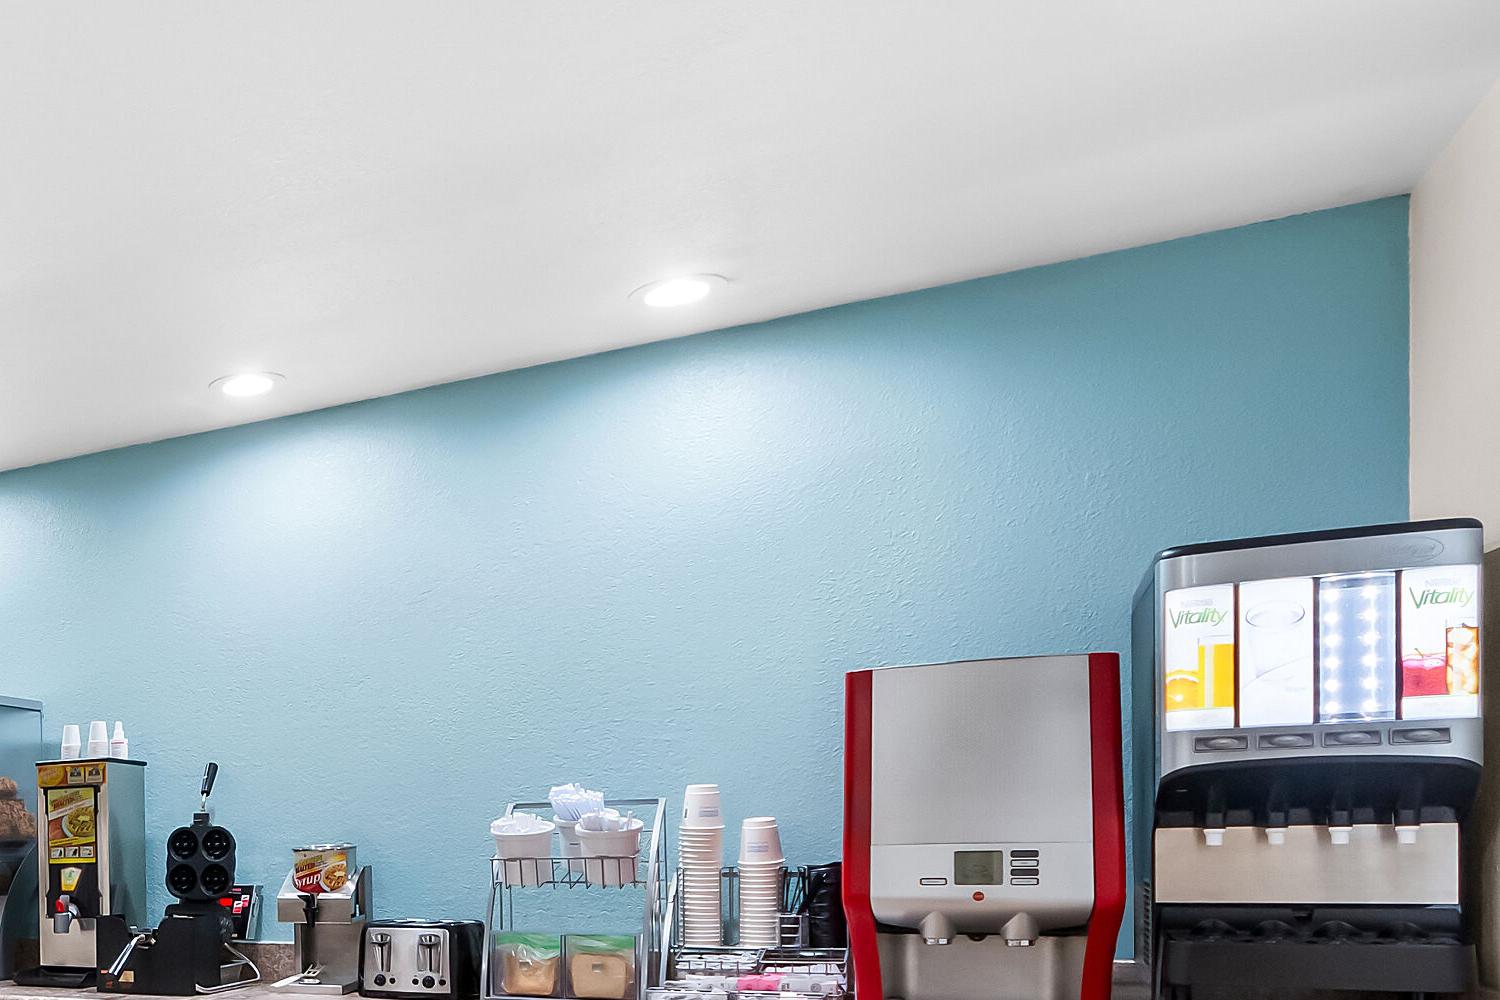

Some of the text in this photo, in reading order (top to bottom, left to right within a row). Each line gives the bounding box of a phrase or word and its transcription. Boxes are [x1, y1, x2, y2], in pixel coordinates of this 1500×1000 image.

[1409, 587, 1475, 609] Vitality
[1169, 607, 1228, 629] Vitality
[294, 873, 321, 888] Syrup
